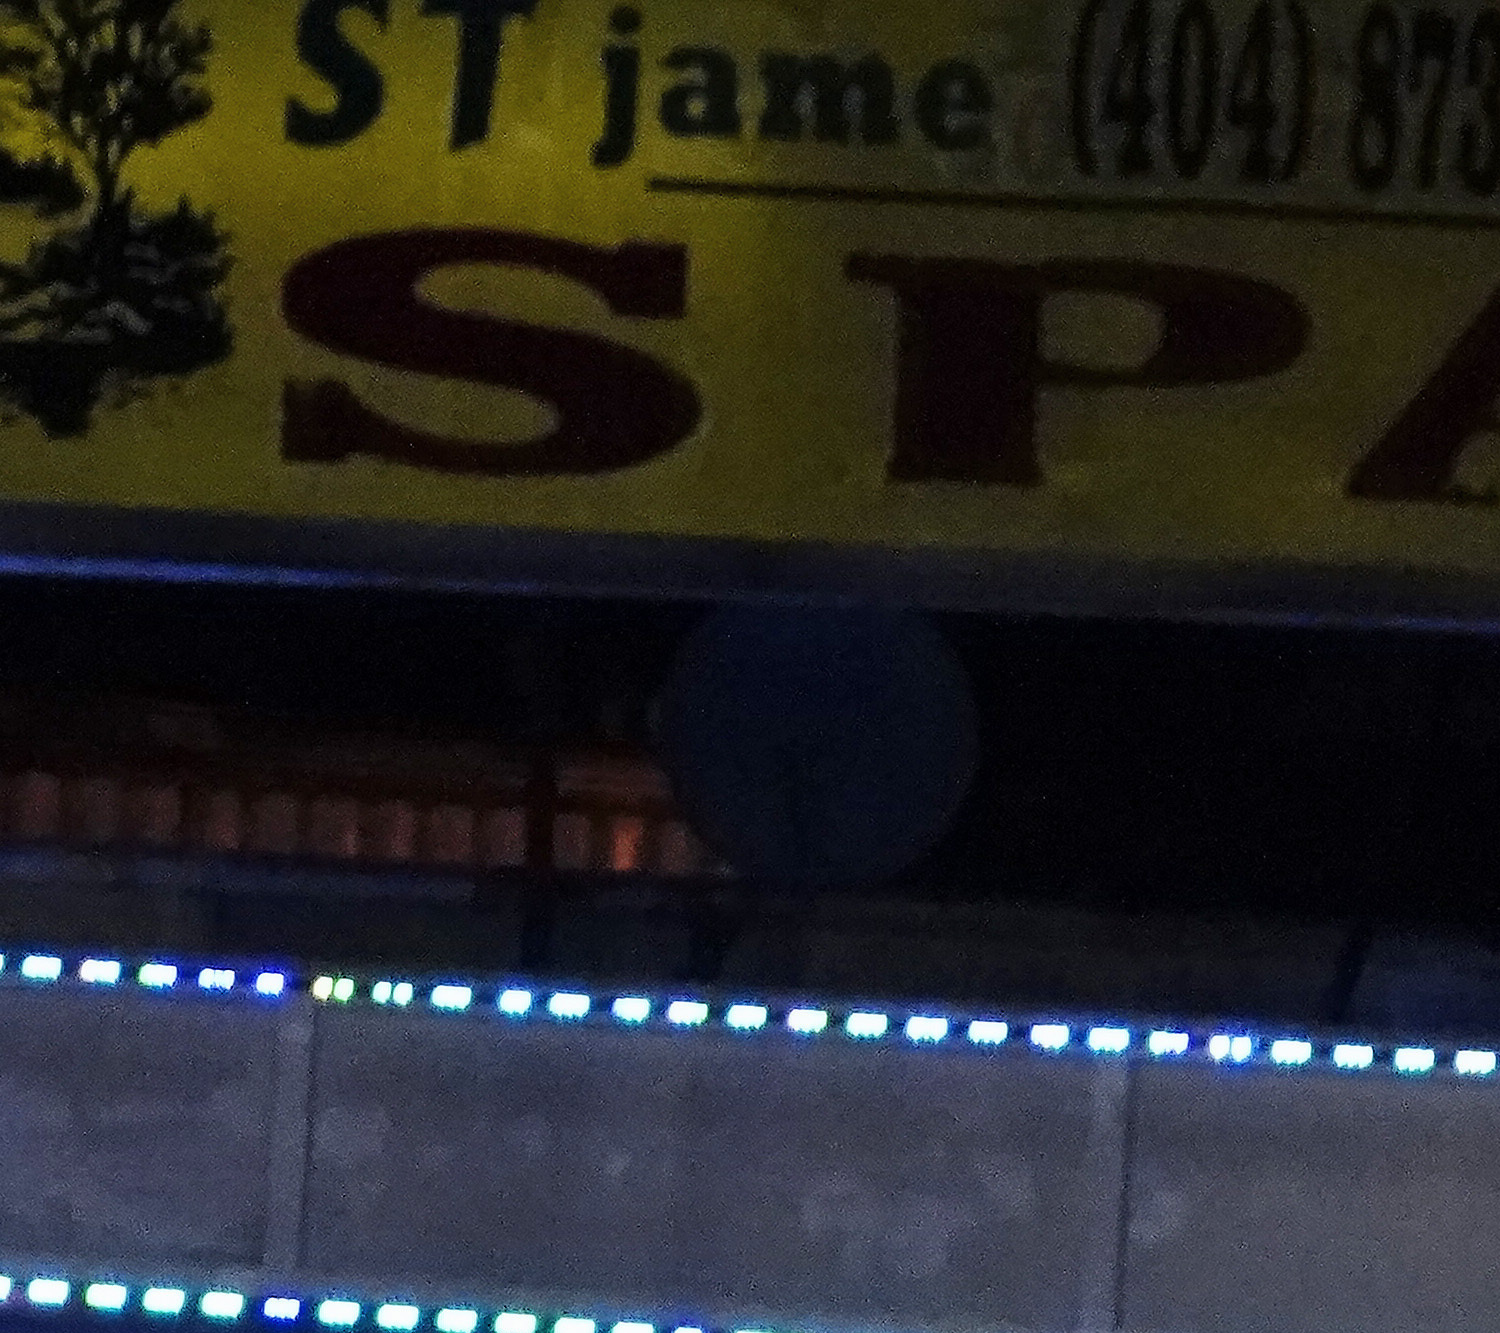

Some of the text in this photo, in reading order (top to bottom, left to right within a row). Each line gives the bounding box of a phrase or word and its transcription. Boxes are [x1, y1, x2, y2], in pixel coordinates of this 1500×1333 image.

[285, 0, 541, 151] ST
[592, 6, 998, 168] jame
[1067, 0, 1314, 180] (404)
